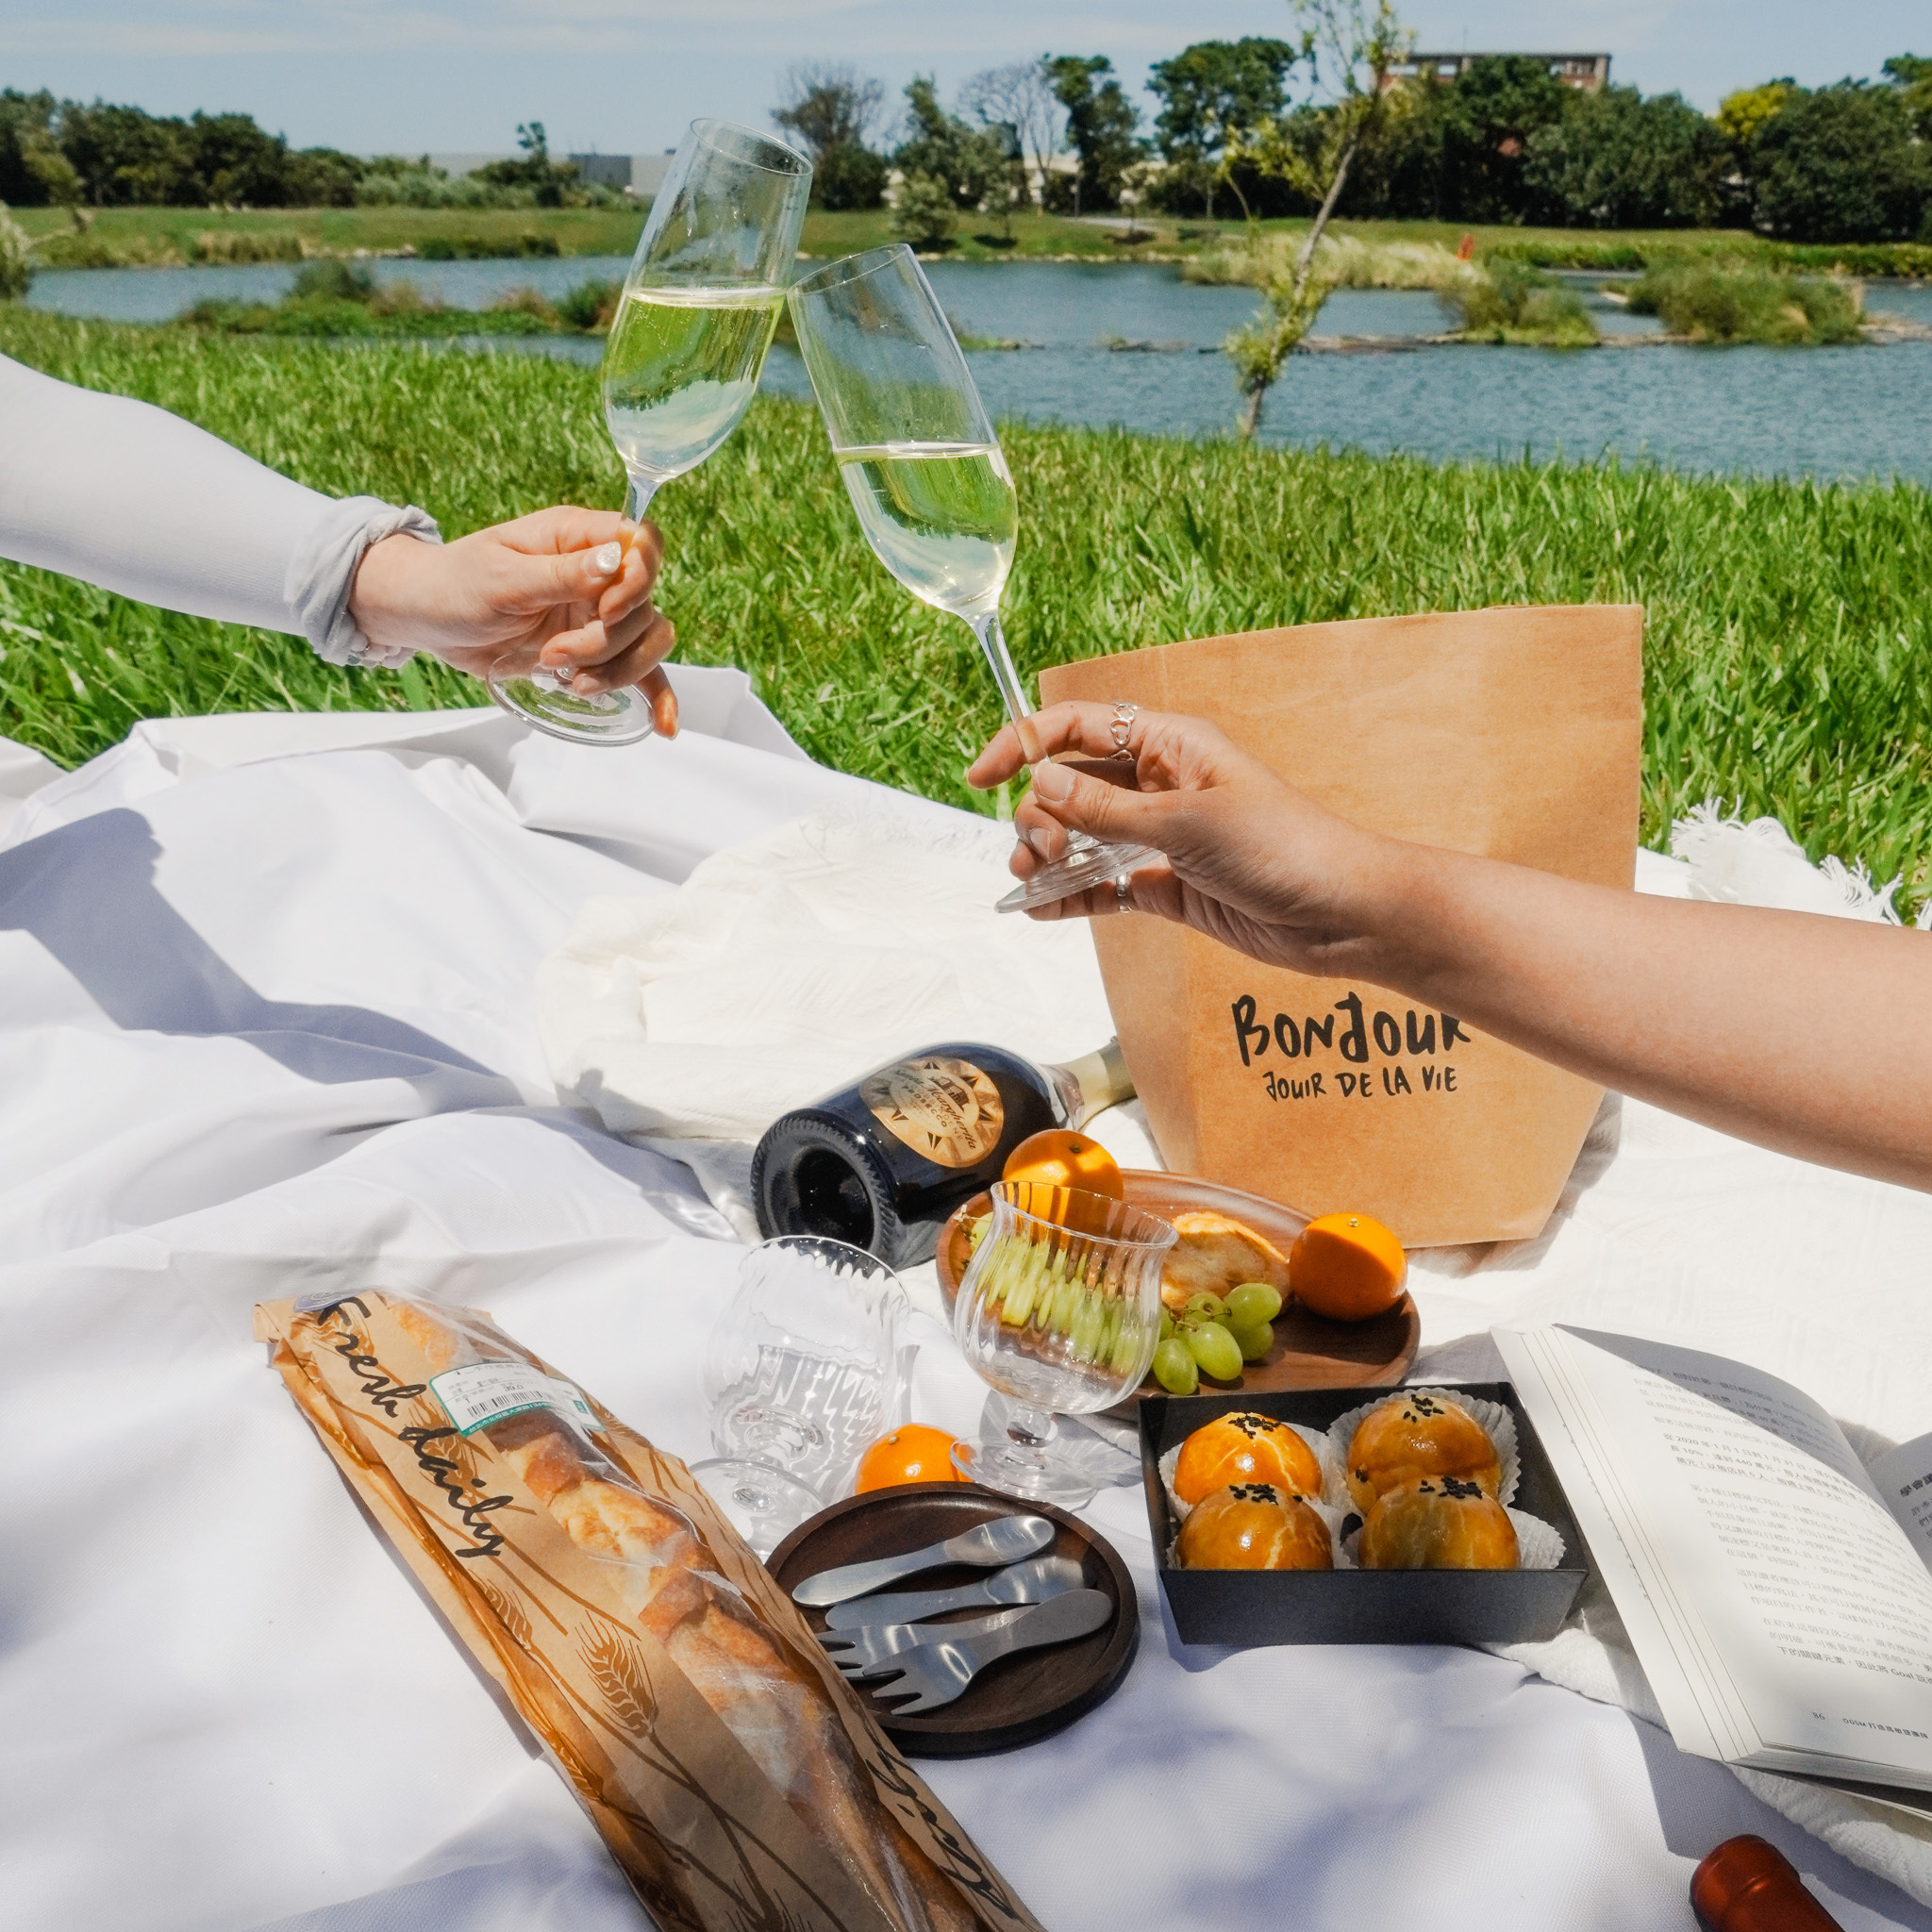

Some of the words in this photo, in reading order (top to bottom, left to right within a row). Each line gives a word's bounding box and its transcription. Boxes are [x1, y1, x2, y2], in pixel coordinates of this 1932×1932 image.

[1262, 1071, 1327, 1102] JOUIR
[1335, 1072, 1374, 1098] DE
[1383, 1066, 1412, 1096] LA
[1422, 1065, 1457, 1092] VIE
[317, 1296, 427, 1418] Fresh
[398, 1426, 514, 1558] daily
